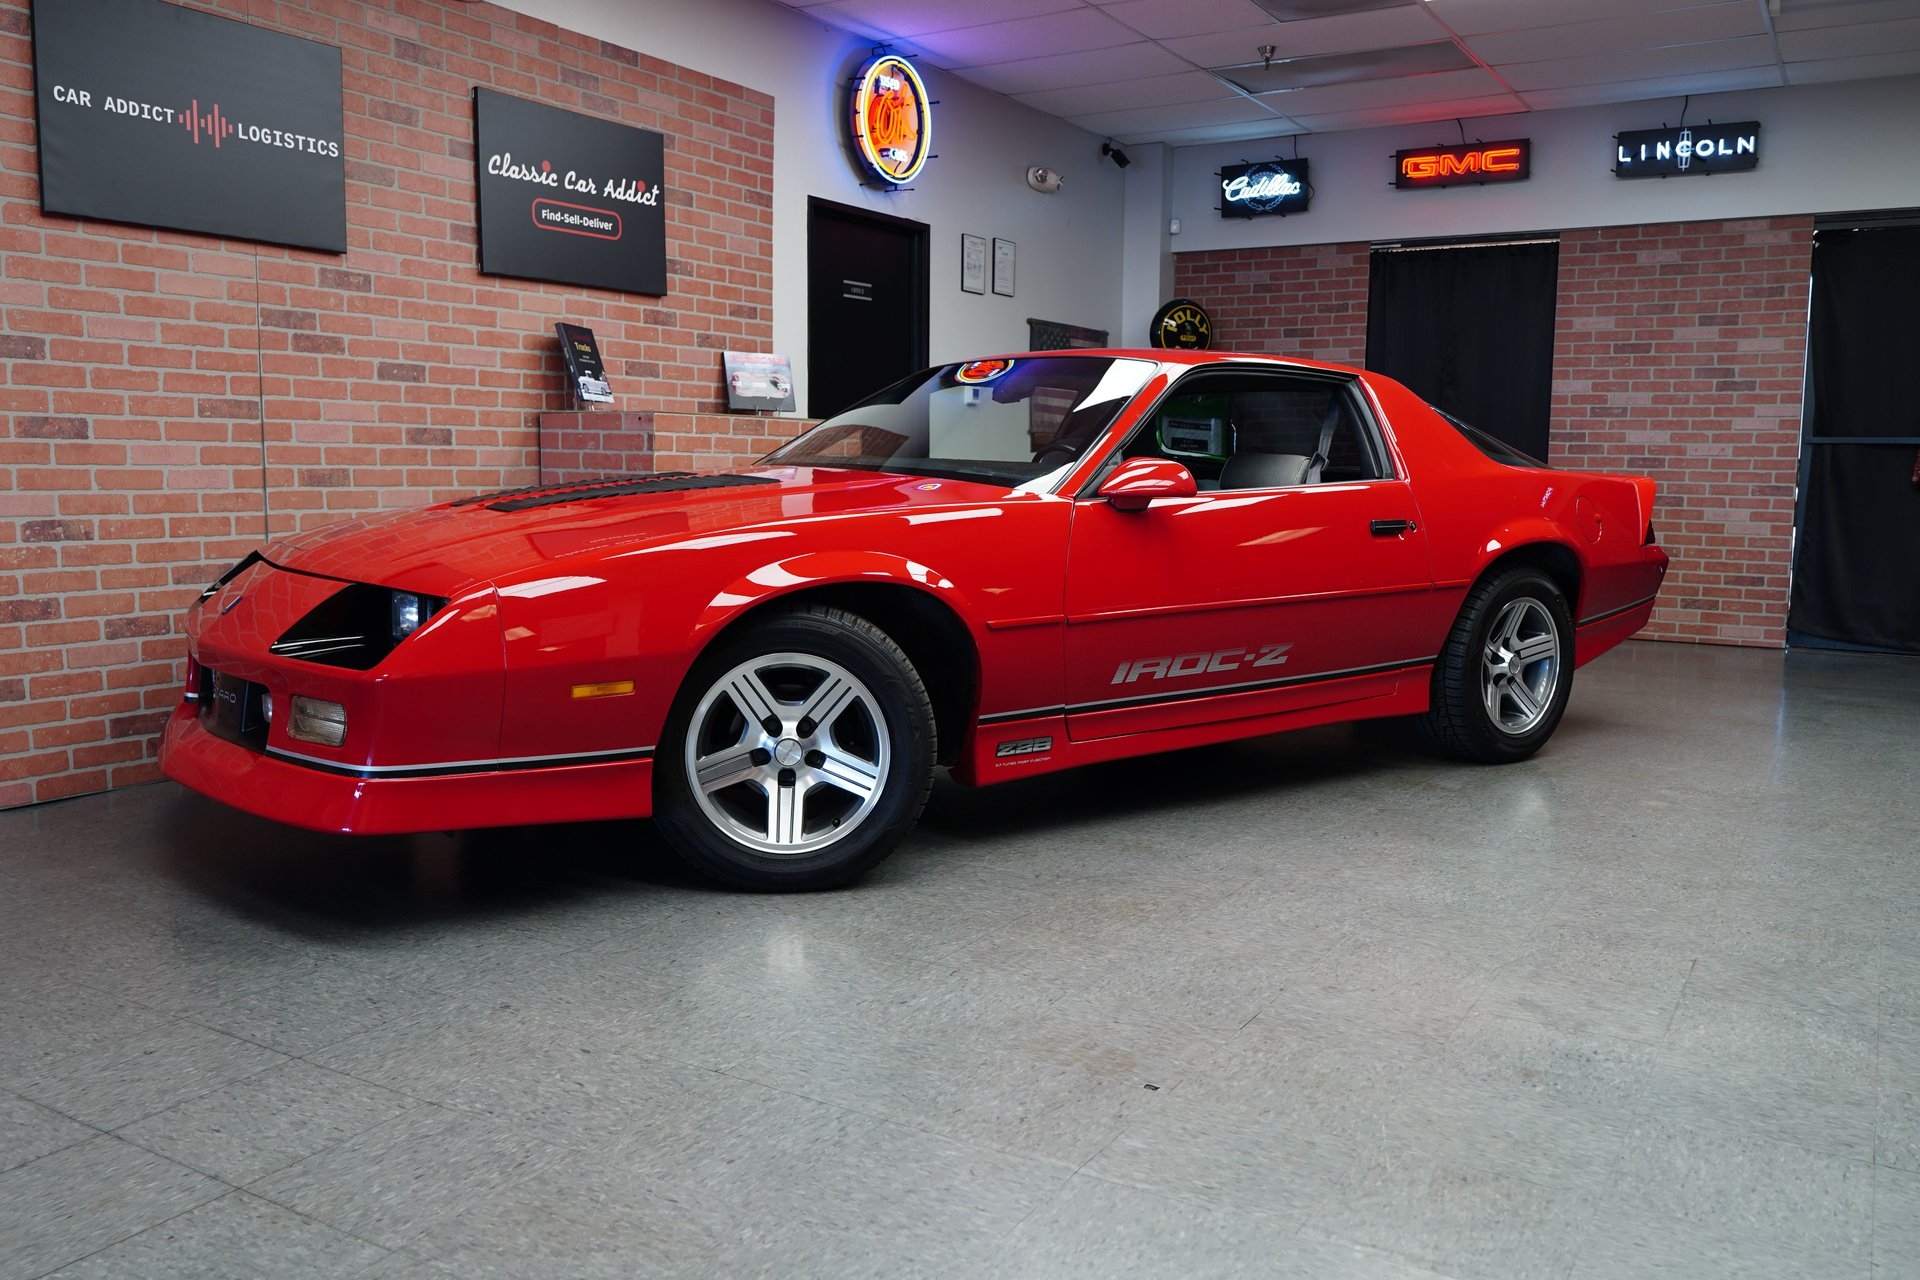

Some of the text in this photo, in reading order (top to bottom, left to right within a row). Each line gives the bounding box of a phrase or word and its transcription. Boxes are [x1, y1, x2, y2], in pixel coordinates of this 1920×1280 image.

[53, 85, 339, 158] CAR ADDICT LOGISTICS
[1402, 148, 1520, 178] GMC
[1618, 136, 1756, 162] LINCOLN
[488, 152, 660, 207] Classic Car Addict
[1222, 173, 1301, 202] Cadillac
[541, 208, 613, 231] Find-Sell-Deliver
[996, 737, 1053, 757] Z28
